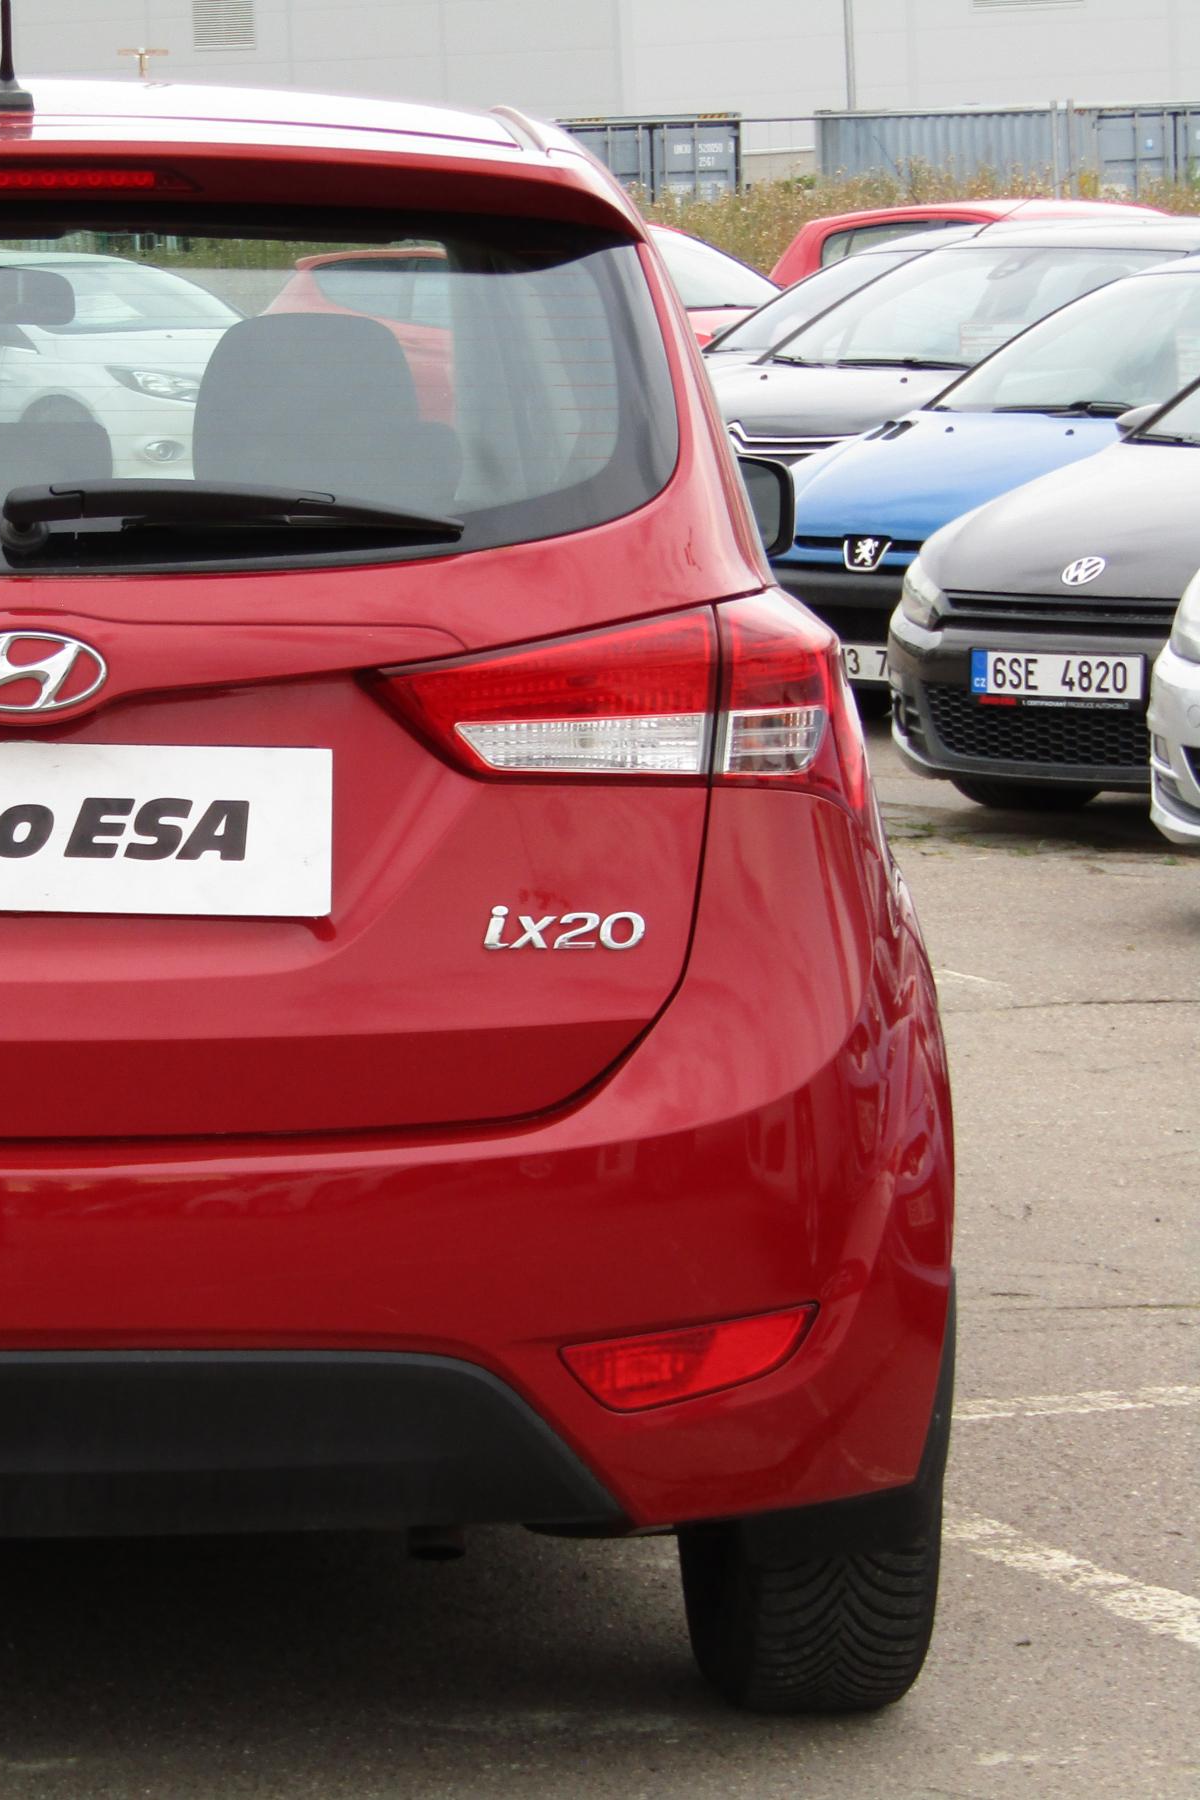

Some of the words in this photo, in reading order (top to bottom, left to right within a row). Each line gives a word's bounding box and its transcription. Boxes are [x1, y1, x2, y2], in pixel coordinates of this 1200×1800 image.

[974, 677, 986, 688] CZ
[993, 657, 1038, 690] 6SE
[1061, 660, 1127, 693] 4820
[63, 797, 250, 861] ESA
[484, 905, 646, 950] ix20
